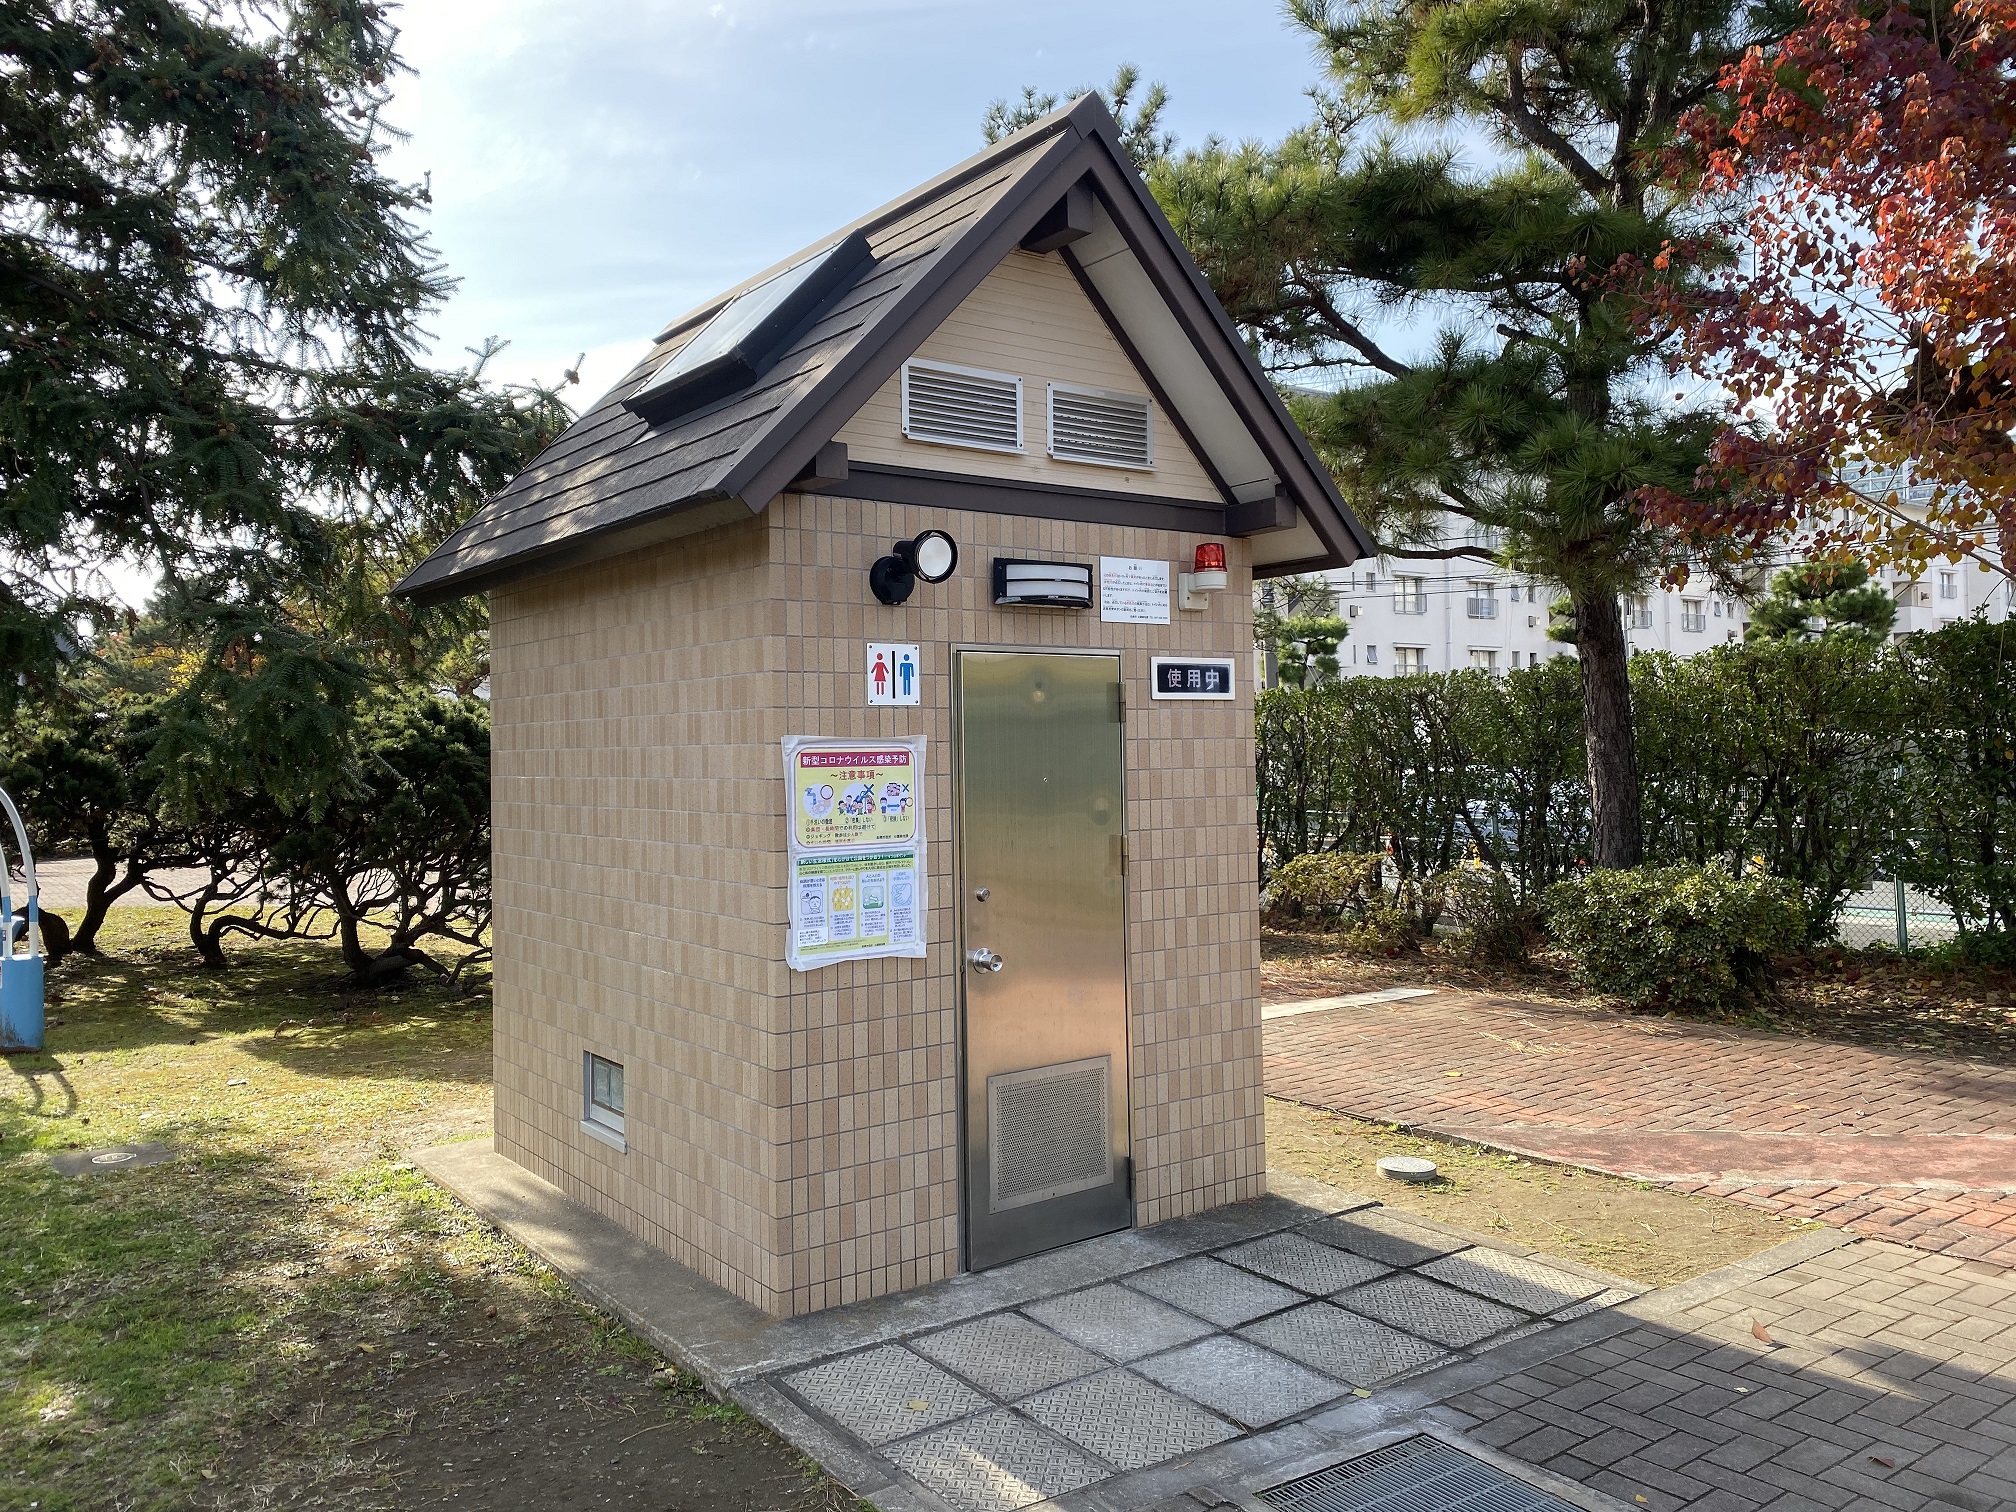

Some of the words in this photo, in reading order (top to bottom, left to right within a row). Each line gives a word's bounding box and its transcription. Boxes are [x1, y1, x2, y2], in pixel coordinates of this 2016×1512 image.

[1167, 668, 1219, 690] 使用中
[802, 755, 907, 766] 新型コロナウイルス感染予防
